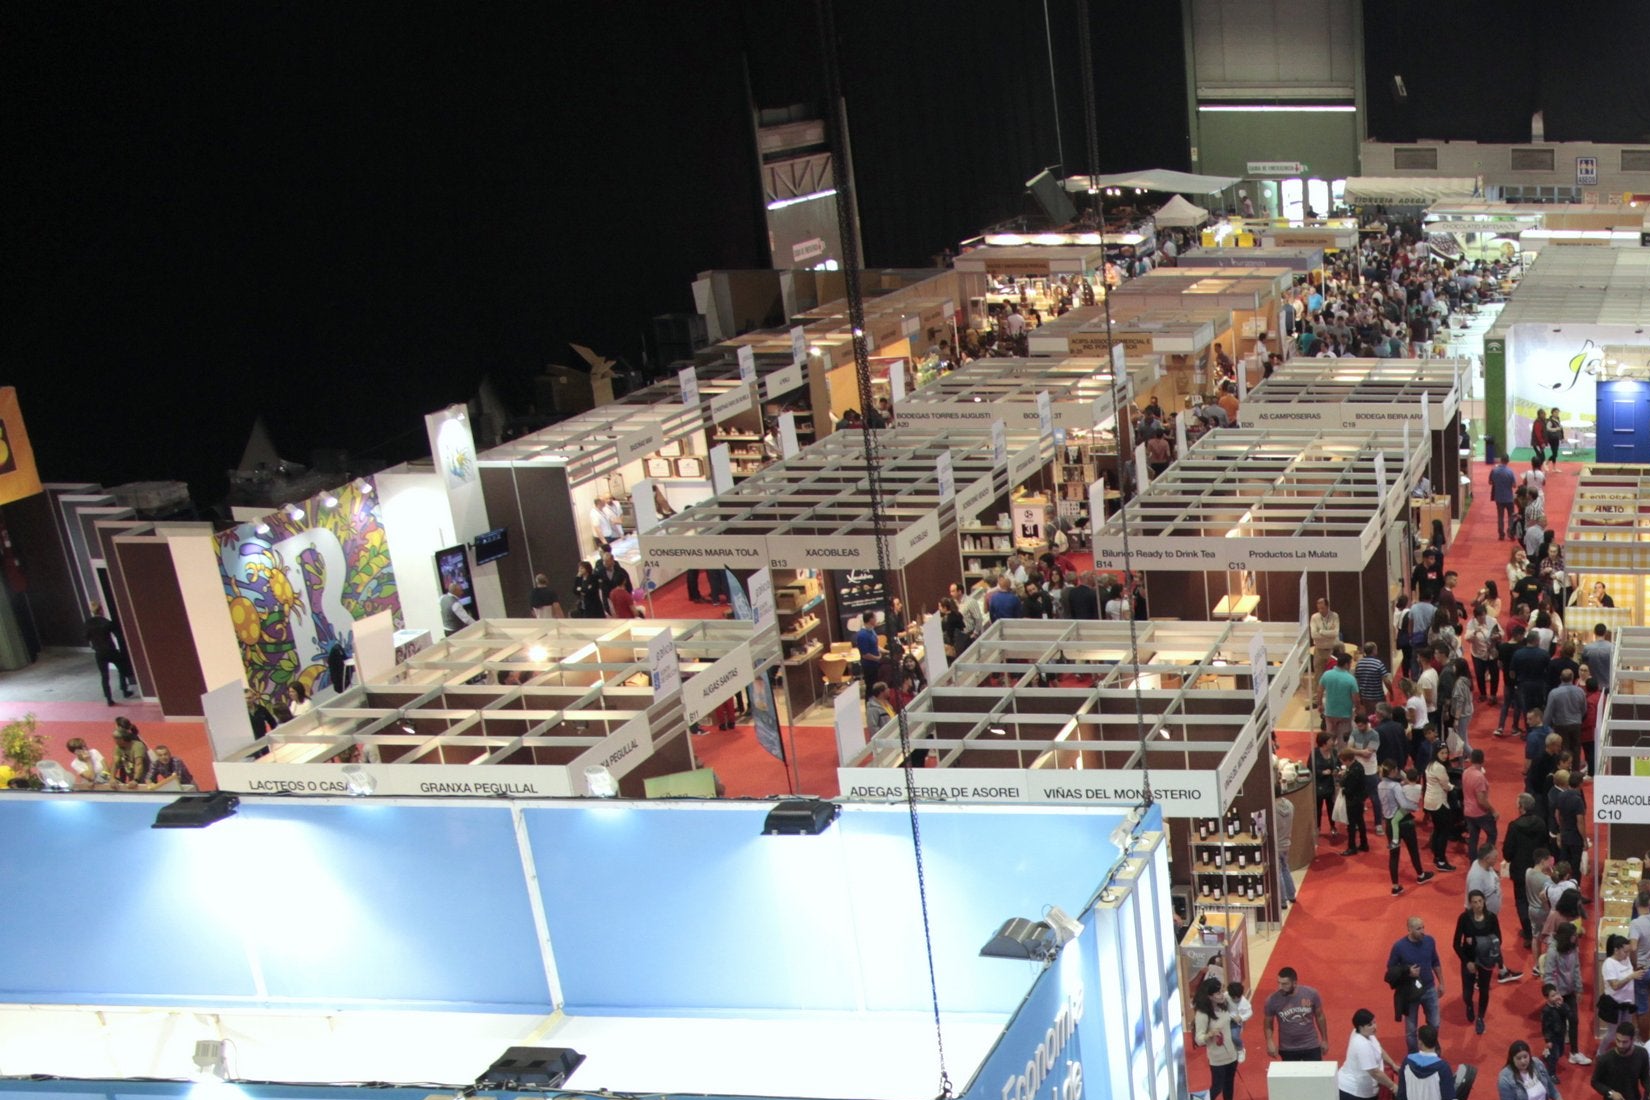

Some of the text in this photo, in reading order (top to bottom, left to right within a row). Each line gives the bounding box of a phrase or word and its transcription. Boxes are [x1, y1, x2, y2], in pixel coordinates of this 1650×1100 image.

[896, 412, 930, 420] BODEGAS
[931, 412, 960, 420] TORRES
[649, 548, 759, 557] CONSERVAS MARIA TOLA
[806, 548, 860, 557] XACOBLEAS
[1136, 549, 1163, 560] Ready
[1165, 549, 1174, 558] to
[1175, 549, 1199, 558] Drink
[1200, 549, 1216, 558] Tea
[1249, 550, 1338, 559] Productos La Mulata
[644, 559, 660, 568] A14
[771, 559, 788, 568] B13
[1096, 560, 1112, 568] B14
[1228, 562, 1246, 570] C13
[702, 667, 739, 698] AUGAS SANTAS
[689, 710, 699, 722] B11
[609, 738, 640, 766] PEGULLAL
[249, 780, 304, 791] LACTEOS
[307, 781, 316, 791] O
[420, 782, 538, 794] GRANXA PEGULLAL
[850, 785, 1020, 798] ADEGAS TERRA DE ASOREI
[1044, 785, 1083, 799] VIÑAS
[1085, 787, 1111, 799] DEL
[1597, 809, 1622, 821] C10
